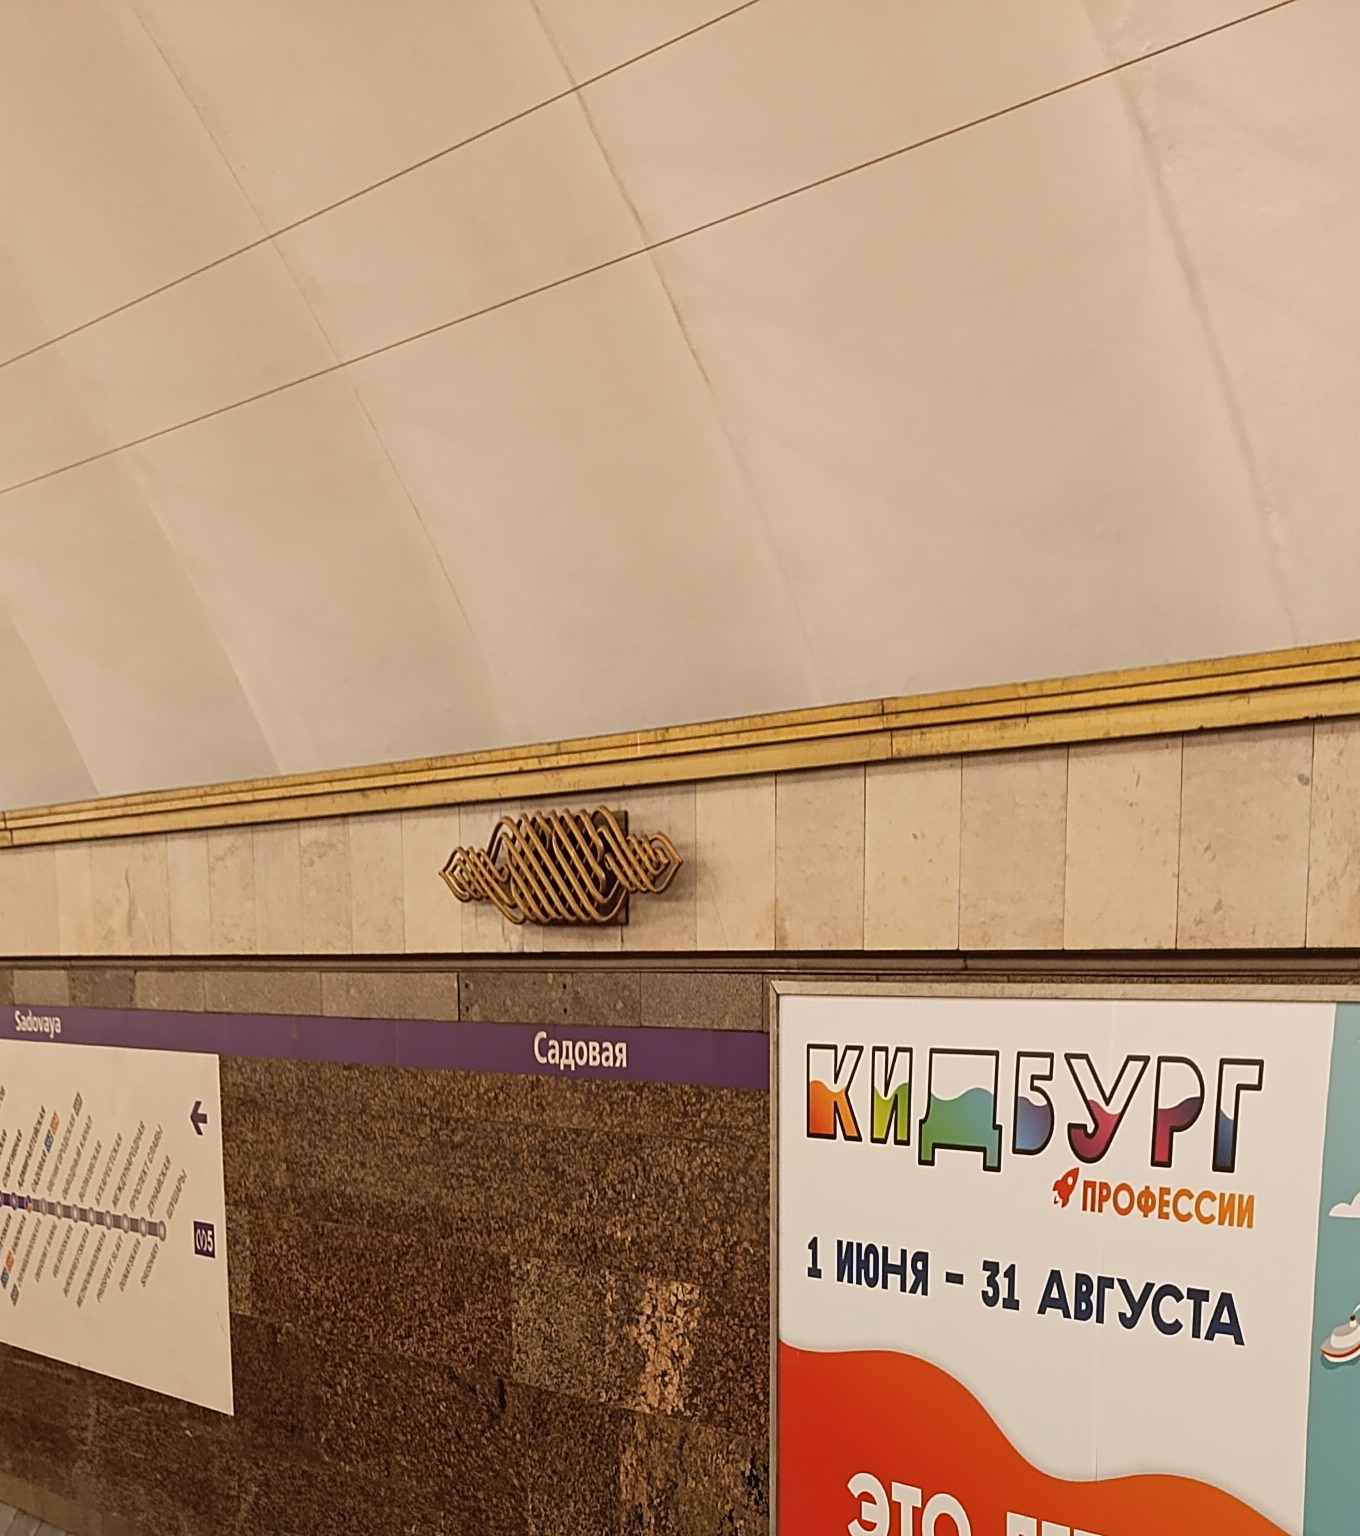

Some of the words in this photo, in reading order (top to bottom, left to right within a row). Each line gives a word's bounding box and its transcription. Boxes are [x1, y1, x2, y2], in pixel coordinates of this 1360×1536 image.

[15, 1009, 61, 1039] Sadovaya
[534, 1031, 628, 1071] Садовая
[806, 1043, 1265, 1174] КИДБУРГ
[1081, 1179, 1255, 1229] ПРОФЕССИИ
[806, 1235, 822, 1279] 1
[836, 1239, 930, 1296] ИЮНЯ
[981, 1259, 1020, 1312] 31
[1037, 1268, 1245, 1346] АВГУСТА
